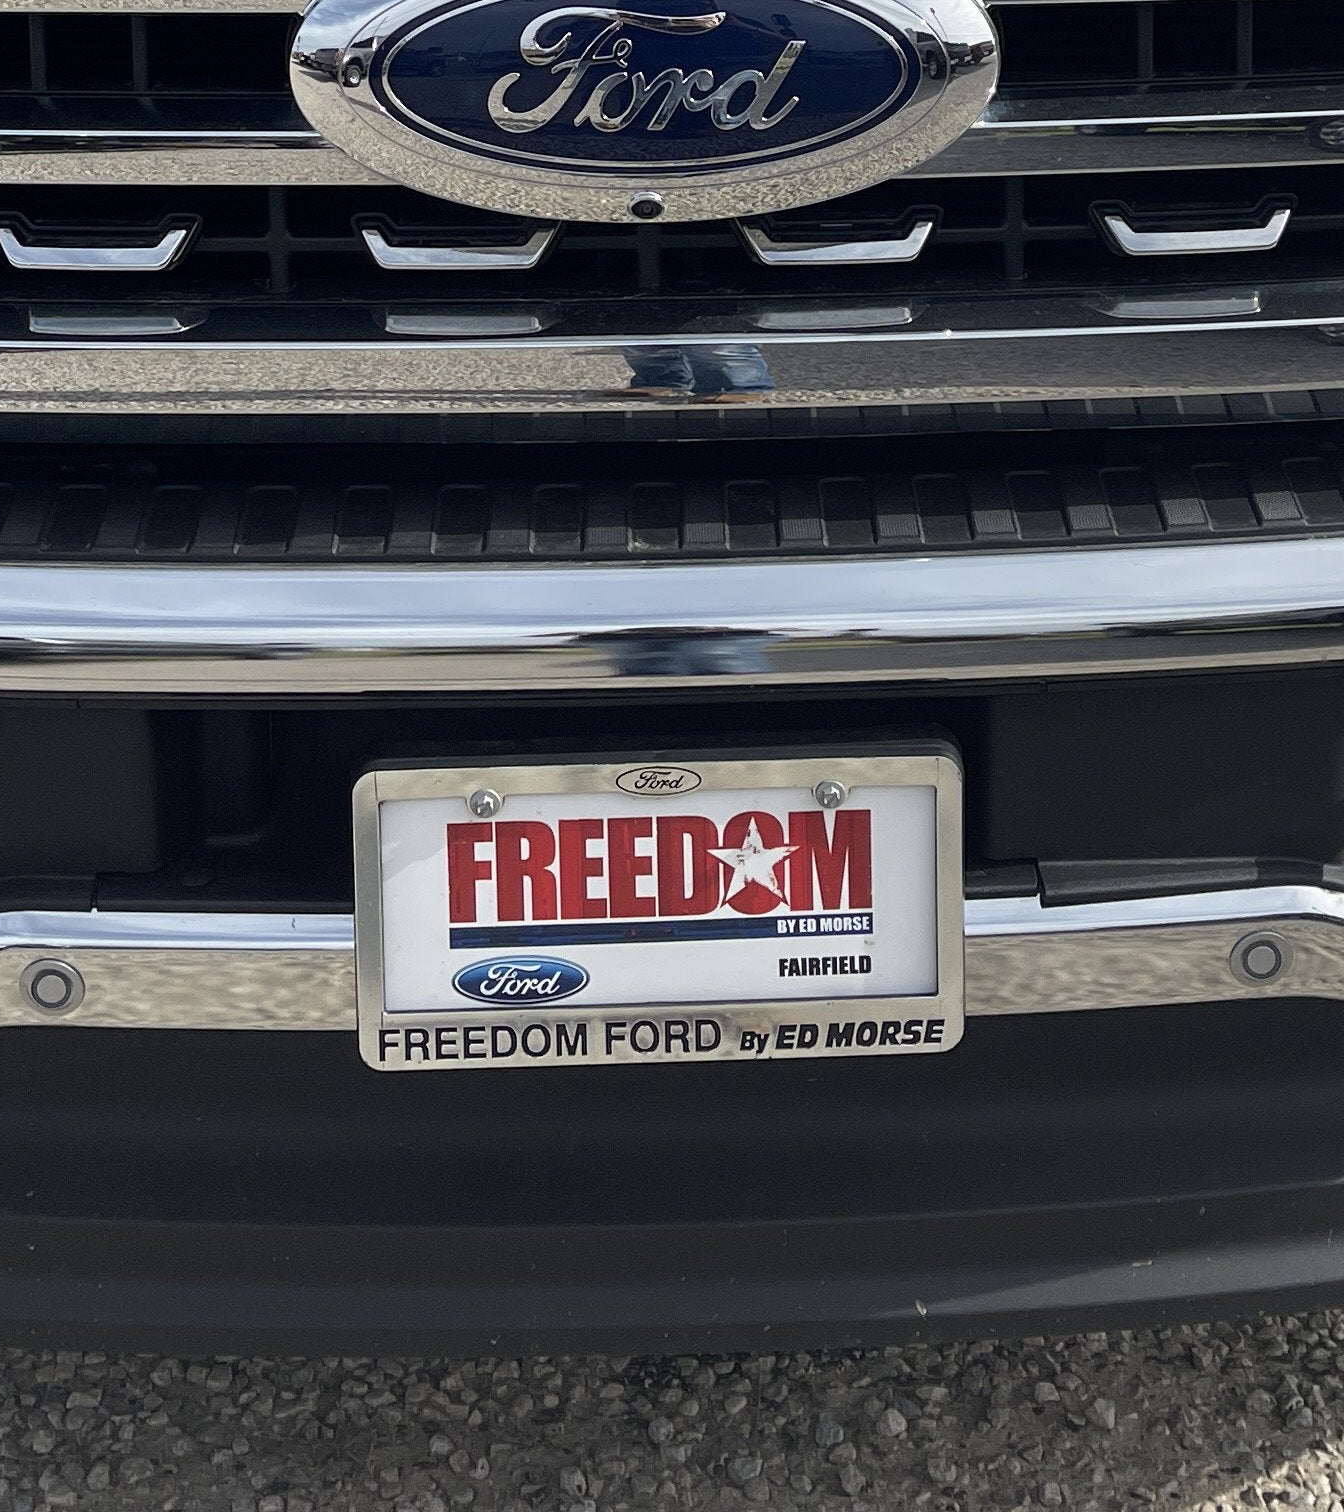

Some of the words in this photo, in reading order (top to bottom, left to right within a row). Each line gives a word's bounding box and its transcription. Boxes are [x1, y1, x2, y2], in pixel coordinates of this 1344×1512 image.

[487, 6, 807, 134] Ford
[633, 769, 686, 791] Ford
[446, 808, 873, 923] FREEDOM
[777, 919, 796, 934] BY
[798, 918, 817, 933] ED
[819, 916, 870, 932] MORSE
[479, 963, 563, 996] Ford
[778, 955, 872, 977] FAIRFIELD
[378, 1022, 588, 1062] FREEDOM
[605, 1019, 722, 1055] FORD
[739, 1031, 770, 1055] By
[774, 1024, 819, 1050] ED
[824, 1019, 946, 1049] MORSE
